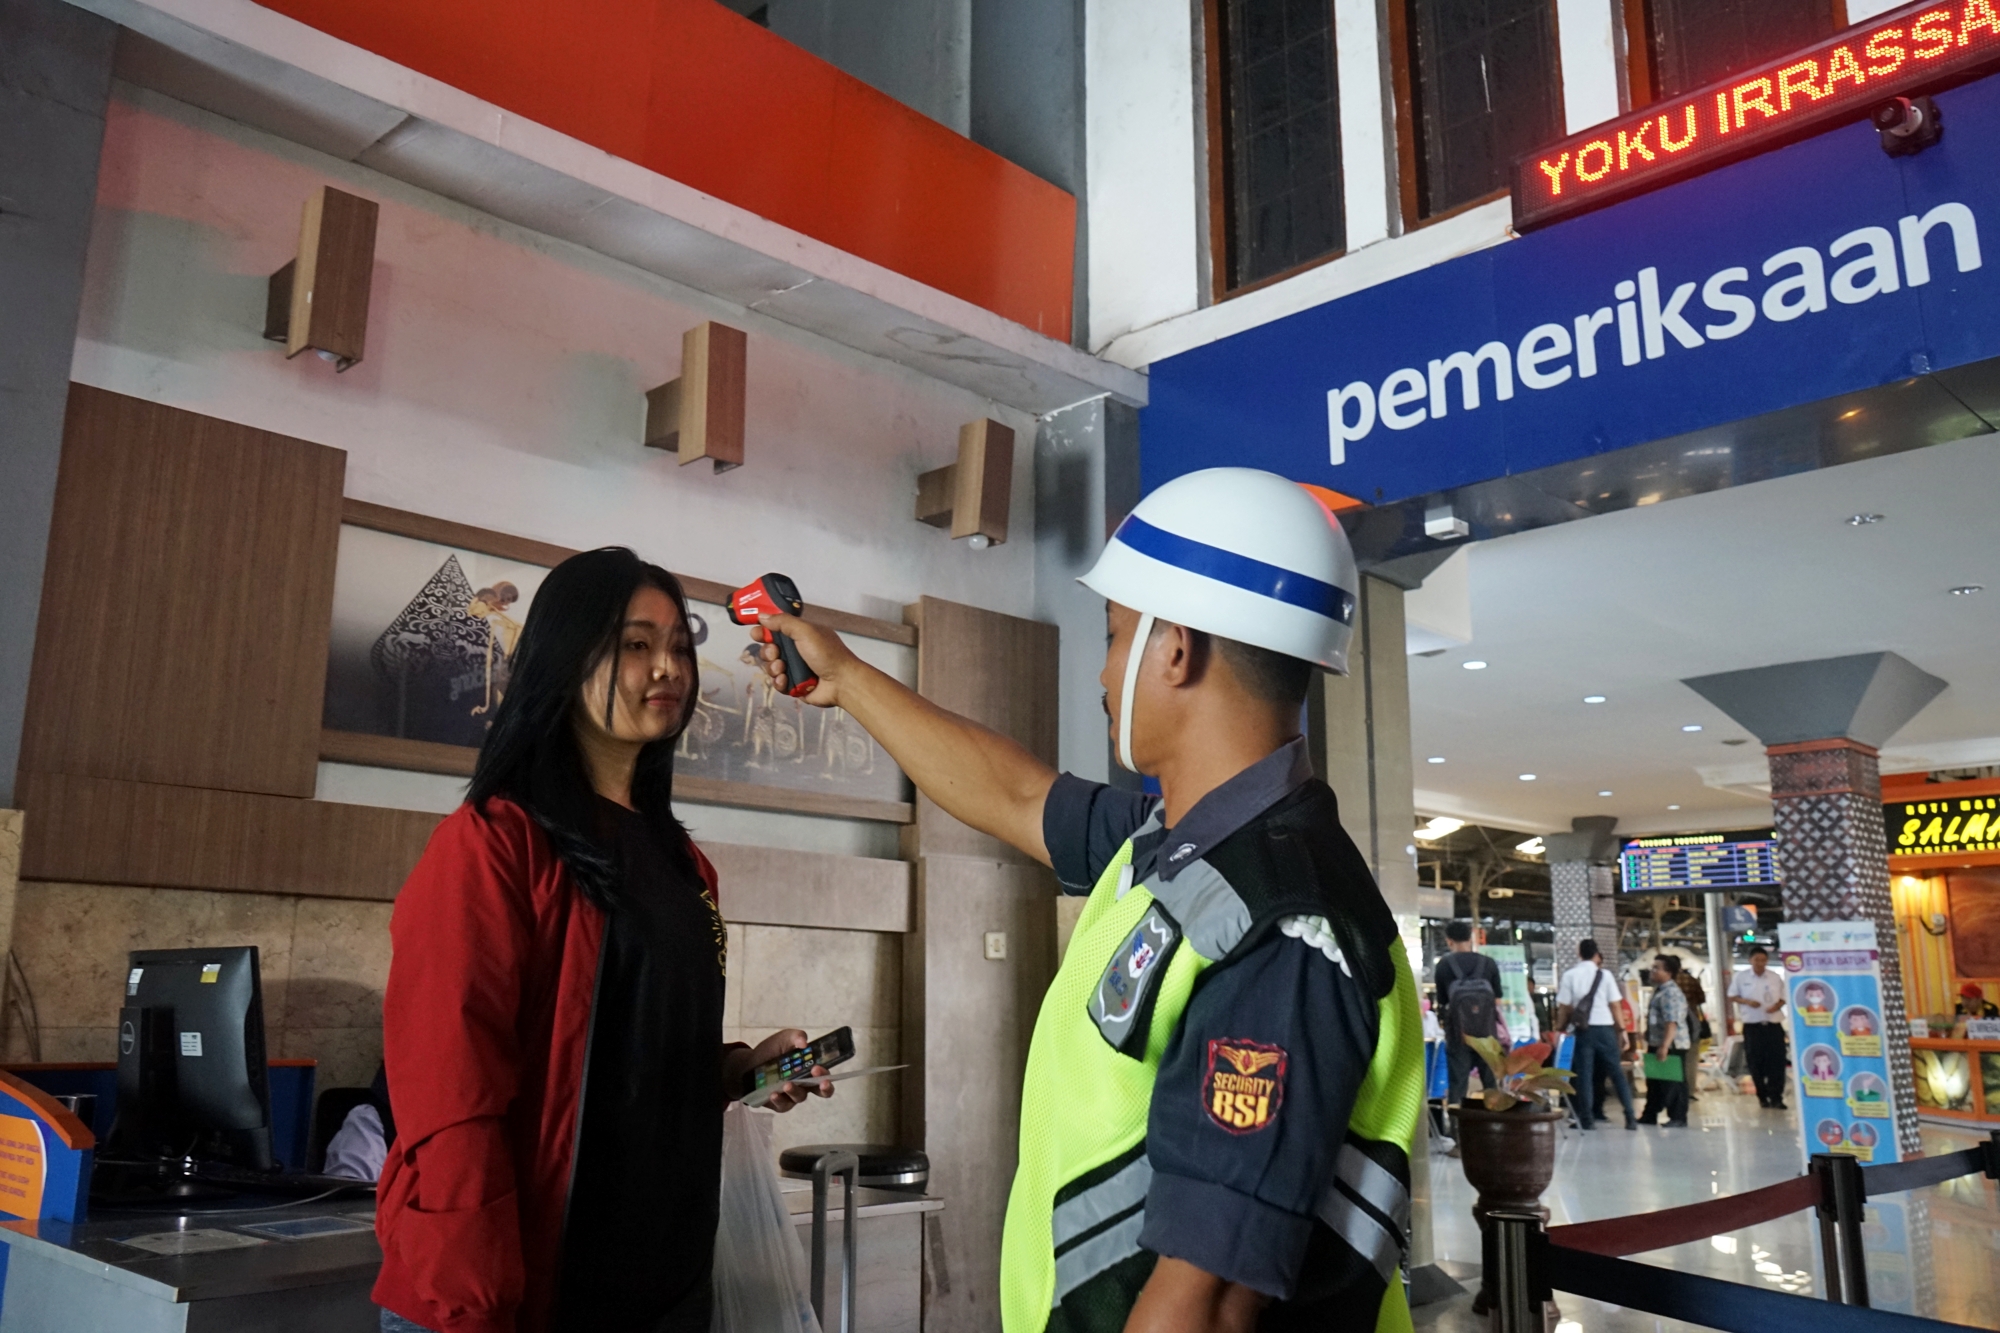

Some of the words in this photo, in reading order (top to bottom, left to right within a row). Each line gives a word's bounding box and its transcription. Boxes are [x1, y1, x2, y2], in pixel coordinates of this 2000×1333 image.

[1540, 106, 1697, 195] YOKU
[1716, 0, 2000, 134] IRRASSA
[1326, 201, 1983, 466] pemeriksaan
[1213, 1071, 1275, 1098] SECURITY
